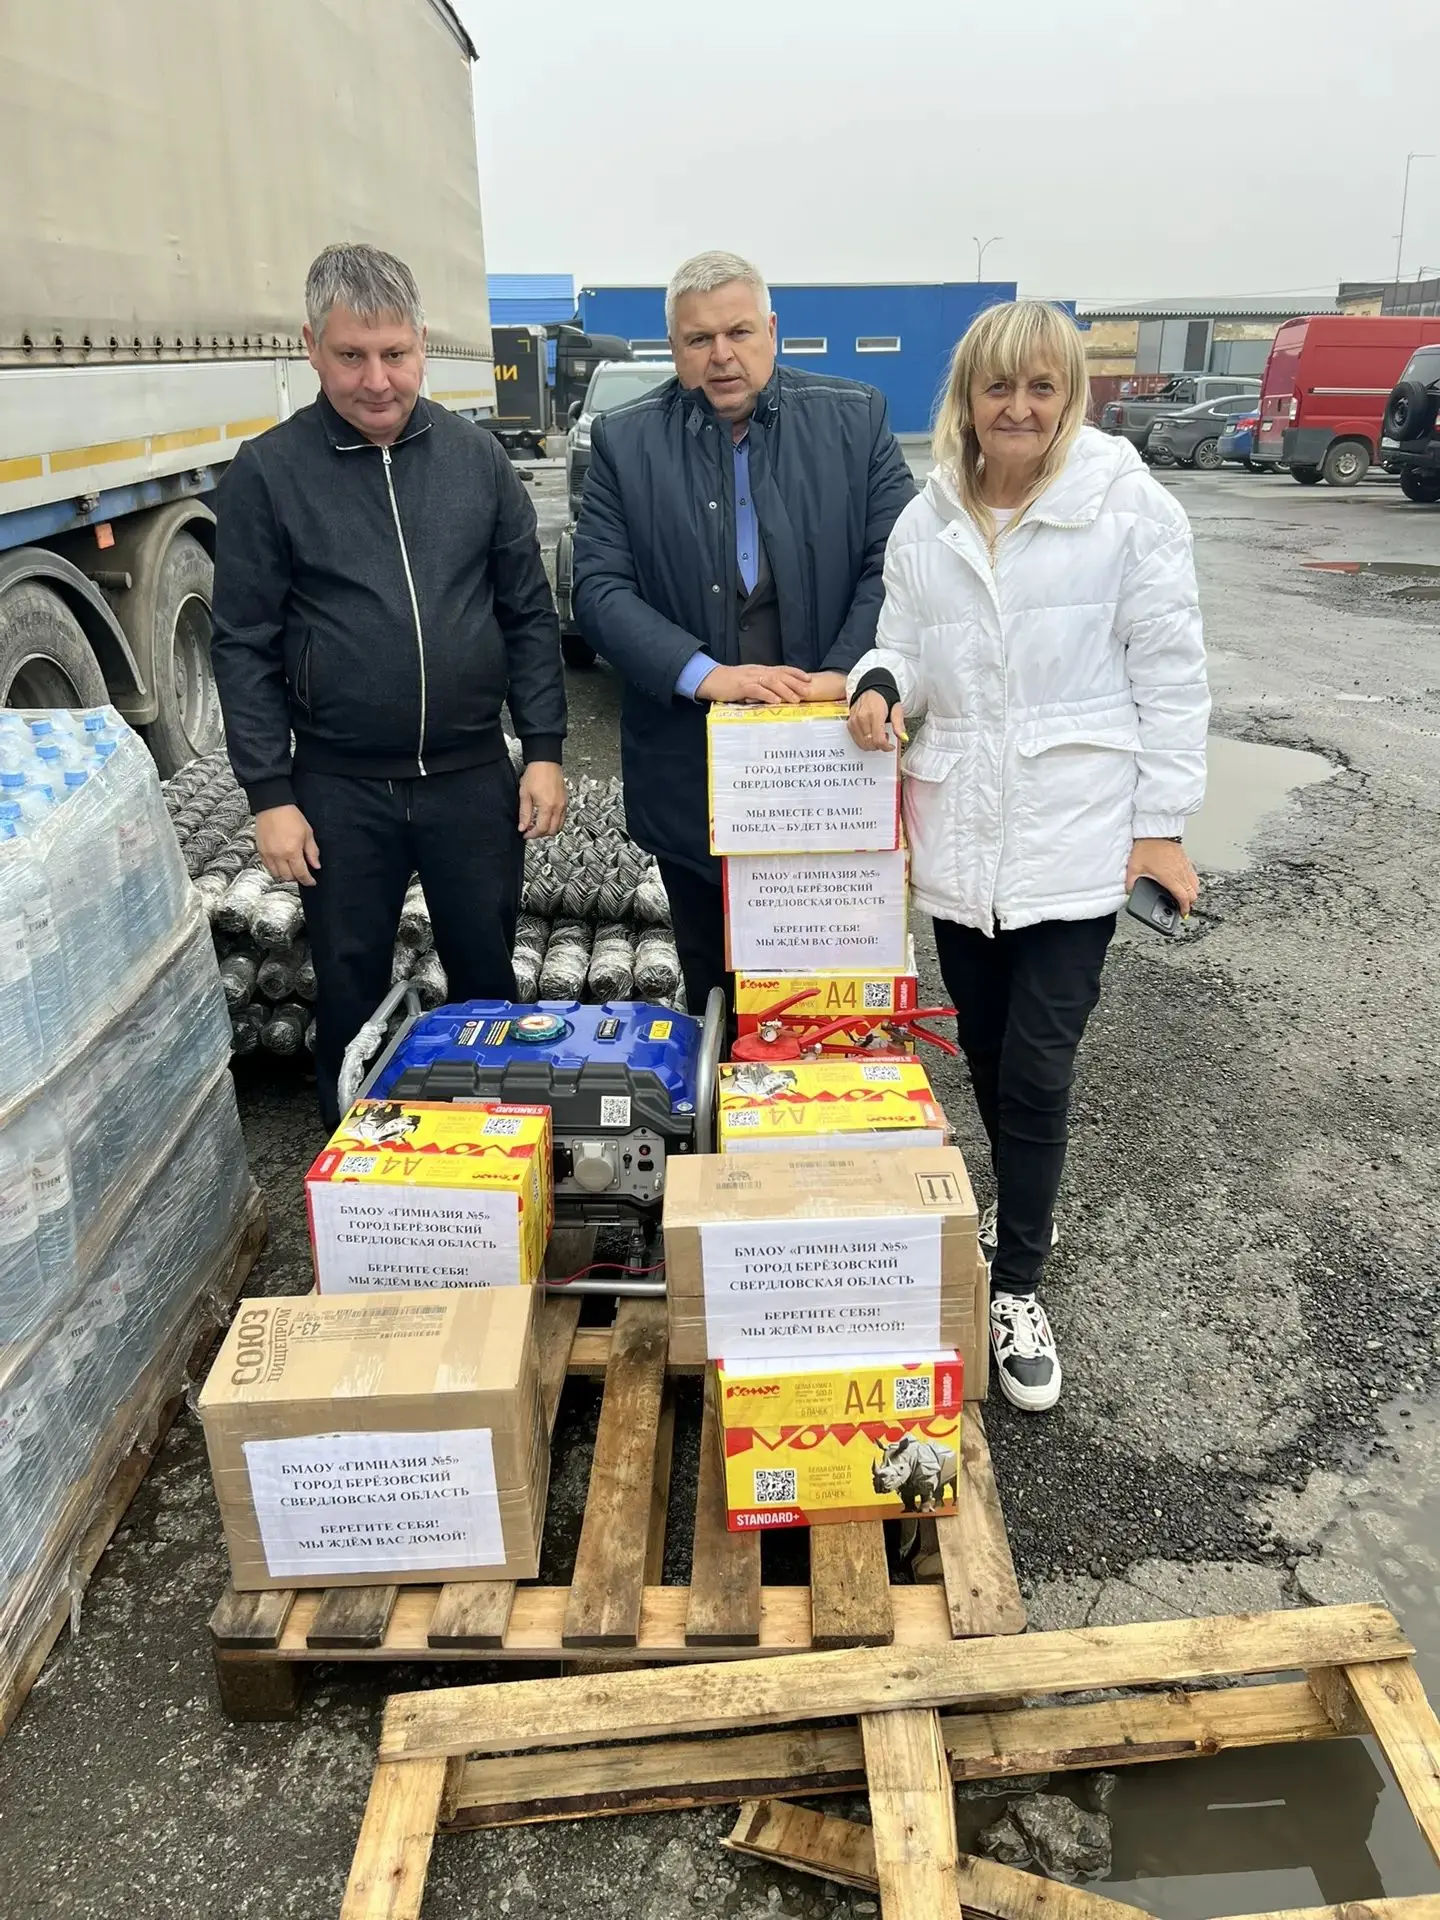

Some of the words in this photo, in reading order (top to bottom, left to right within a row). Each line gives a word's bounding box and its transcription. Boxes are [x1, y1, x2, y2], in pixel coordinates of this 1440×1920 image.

[764, 750, 825, 759] ГИМНАЗИЯ
[828, 749, 845, 758] №5
[745, 765, 782, 774] ГОРОД
[733, 779, 821, 789] СВЕРДЛОВСКАЯ
[824, 778, 876, 786] ОБЛАСТЬ
[746, 810, 765, 818] МЫ
[769, 808, 814, 817] ВМЕСТЕ
[816, 808, 824, 816] С
[827, 808, 862, 816] ВАМИ!
[732, 824, 776, 832] ПОБЕДА
[787, 822, 822, 832] БУДЕТ
[825, 822, 836, 831] ЗА
[840, 821, 877, 830] НАМИ!
[793, 871, 856, 879] «ГИМНАЗИЯ
[860, 870, 880, 879] №5»
[760, 885, 794, 894] ГОРОД
[797, 884, 872, 892] БЕРЁЗОВСКИЙ
[748, 898, 832, 908] СВЕРДЛОВСКАЯ
[835, 896, 885, 906] ОБЛАСТЬ
[774, 925, 826, 933] БЕРЕГИТЕ
[756, 938, 774, 946] МЫ
[778, 937, 808, 947] ЖДЁМ
[813, 938, 832, 946] ВАС
[835, 936, 878, 946] ДОМОЙ!
[341, 1206, 384, 1215] БМАОУ
[388, 1207, 462, 1219] «ГИМНАЗИЯ
[466, 1211, 490, 1220] №5»
[349, 1221, 391, 1231] ГОРОД
[394, 1222, 482, 1234] БЕРЁЗОВСКИЙ
[337, 1234, 434, 1247] СВЕРДЛОВСКАЯ
[438, 1239, 497, 1249] ОБЛАСТЬ
[735, 1246, 785, 1257] БМАОУ
[790, 1243, 876, 1255] «ГИМНАЗИЯ
[881, 1242, 908, 1252] №5»
[368, 1264, 430, 1274] БЕРЕГИТЕ
[433, 1266, 469, 1275] СЕБЯ!
[745, 1262, 792, 1273] ГОРОД
[796, 1257, 898, 1271] БЕРЁЗОВСКИЙ
[349, 1276, 369, 1285] МЫ
[373, 1277, 410, 1287] ЖДЁМ
[414, 1280, 438, 1288] ВАС
[730, 1278, 843, 1291] СВЕРДЛОВСКАЯ
[847, 1275, 914, 1287] ОБЛАСТЬ
[765, 1309, 835, 1320] БЕРЕГИТЕ
[840, 1308, 881, 1318] СЕБЯ!
[741, 1327, 765, 1336] МЫ
[769, 1325, 812, 1336] ЖДЁМ
[818, 1325, 844, 1334] ВАС
[848, 1321, 905, 1334] ДОМОЙ!
[231, 1309, 270, 1386] СОЮЗ
[267, 1307, 292, 1383] ПИЩЕПРОМ
[282, 1464, 334, 1474] БМАОУ
[339, 1457, 427, 1472] «ГИМНАЗИЯ
[431, 1456, 459, 1466] №5»
[294, 1479, 343, 1490] ГОРОД
[346, 1470, 450, 1488] БЕРЁЗОВСКИЙ
[281, 1493, 396, 1507] СВЕРДЛОВСКАЯ
[401, 1487, 469, 1500] ОБЛАСТЬ
[736, 1512, 800, 1527] STANDARD+
[321, 1522, 393, 1534] БЕРЕГИТЕ
[397, 1520, 439, 1531] СЕБЯ!
[298, 1540, 324, 1549] МЫ
[327, 1536, 372, 1547] ЖДЁМ
[377, 1536, 405, 1545] ВАС
[408, 1531, 467, 1545] ДОМОЙ!
